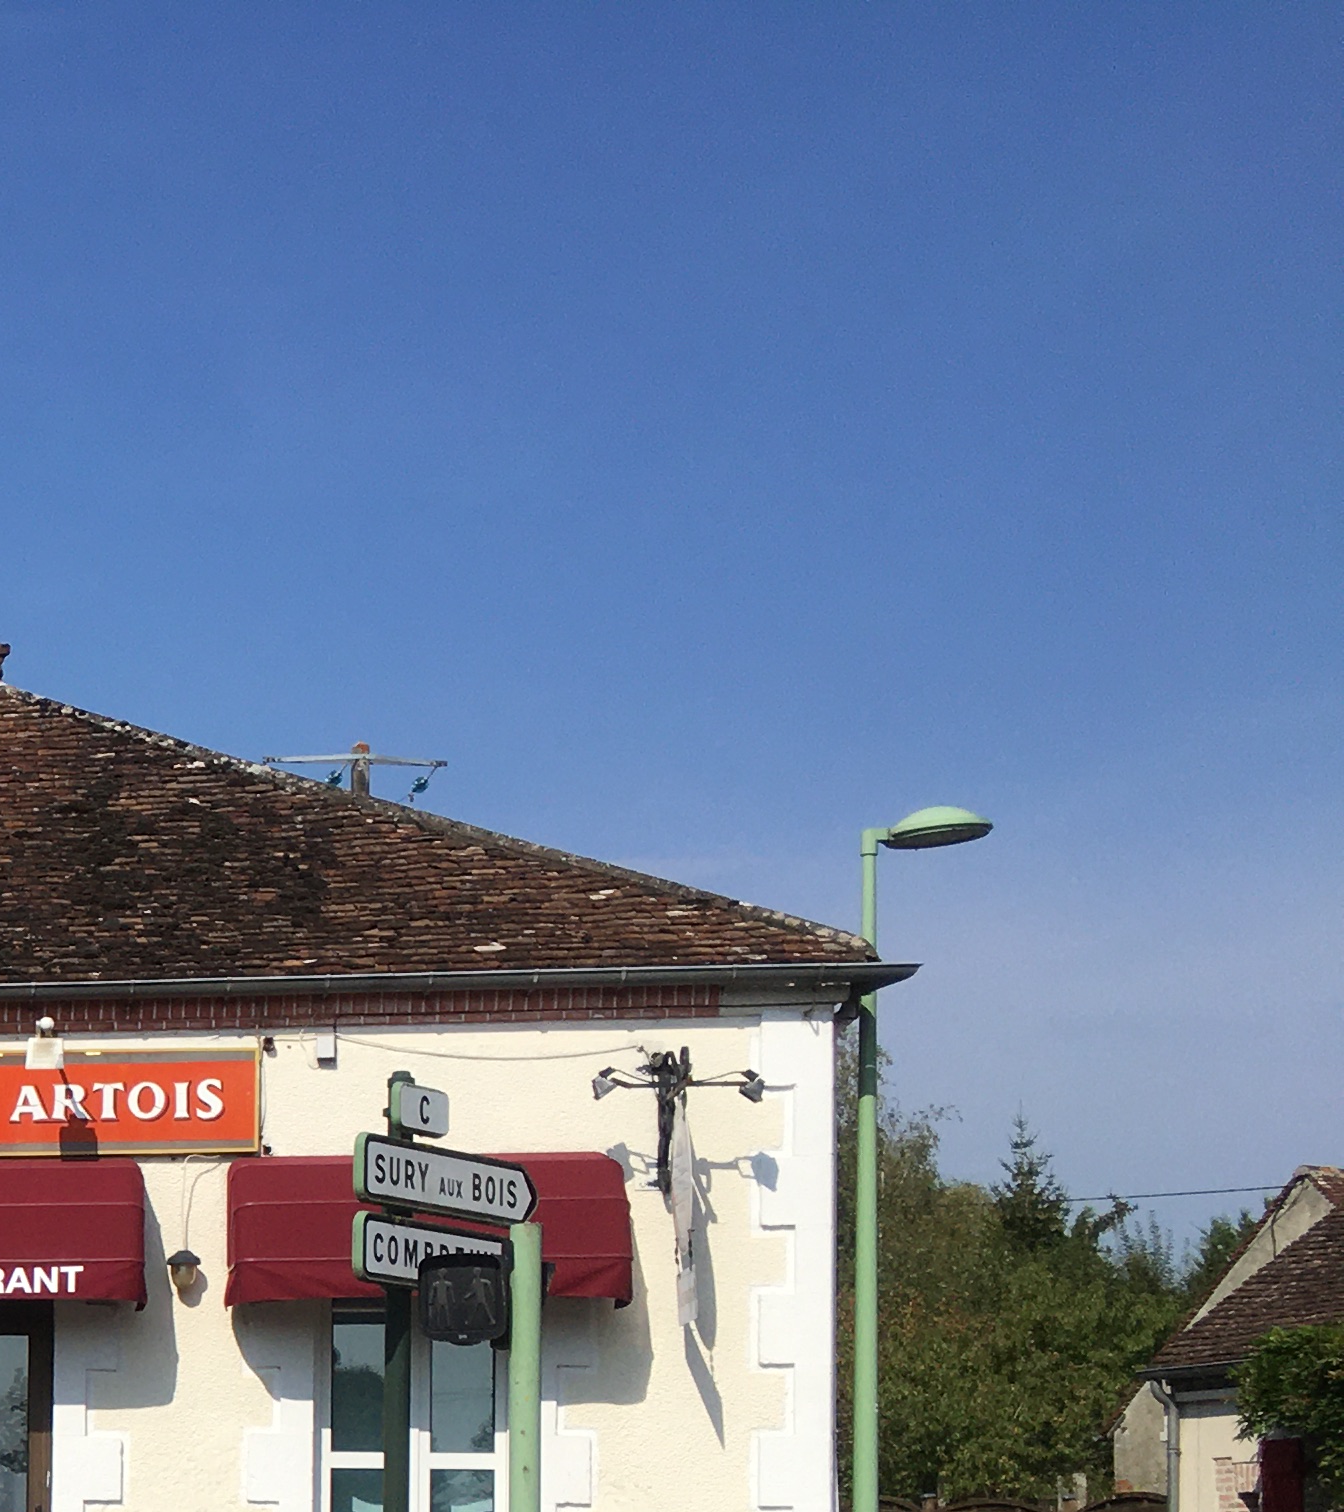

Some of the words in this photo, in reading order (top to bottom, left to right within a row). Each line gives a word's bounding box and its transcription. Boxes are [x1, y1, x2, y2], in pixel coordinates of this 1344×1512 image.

[9, 1078, 224, 1123] ARTOIS
[419, 1095, 430, 1125] C
[374, 1154, 429, 1192] SURY
[438, 1176, 463, 1199] AUX
[472, 1172, 517, 1209] BOIS
